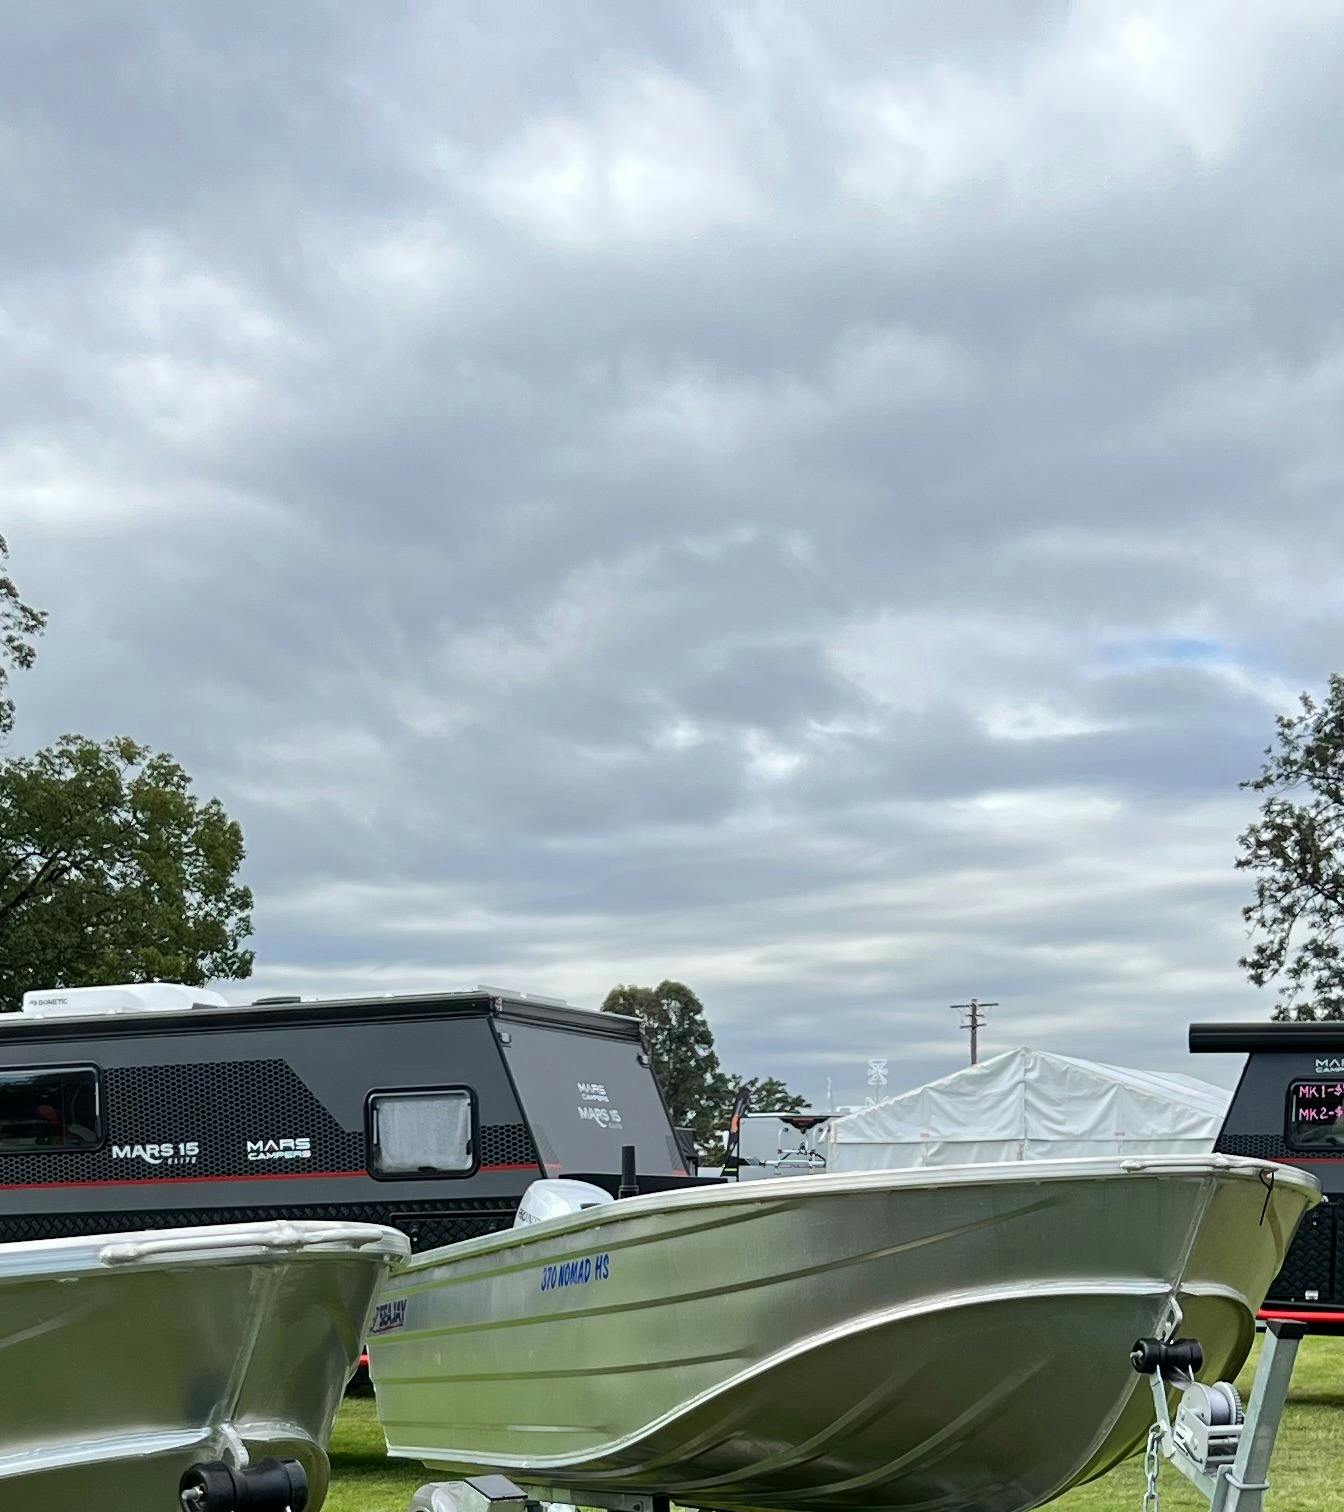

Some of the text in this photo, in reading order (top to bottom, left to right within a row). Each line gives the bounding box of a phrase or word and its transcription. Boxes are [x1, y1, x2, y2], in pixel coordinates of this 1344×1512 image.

[1298, 1086, 1319, 1099] MK
[1298, 1107, 1319, 1122] MK
[246, 1137, 311, 1152] MARS
[111, 1142, 200, 1165] MARS 15
[247, 1150, 312, 1161] CAMPERS
[540, 1253, 610, 1292] 370 NOMAD HS
